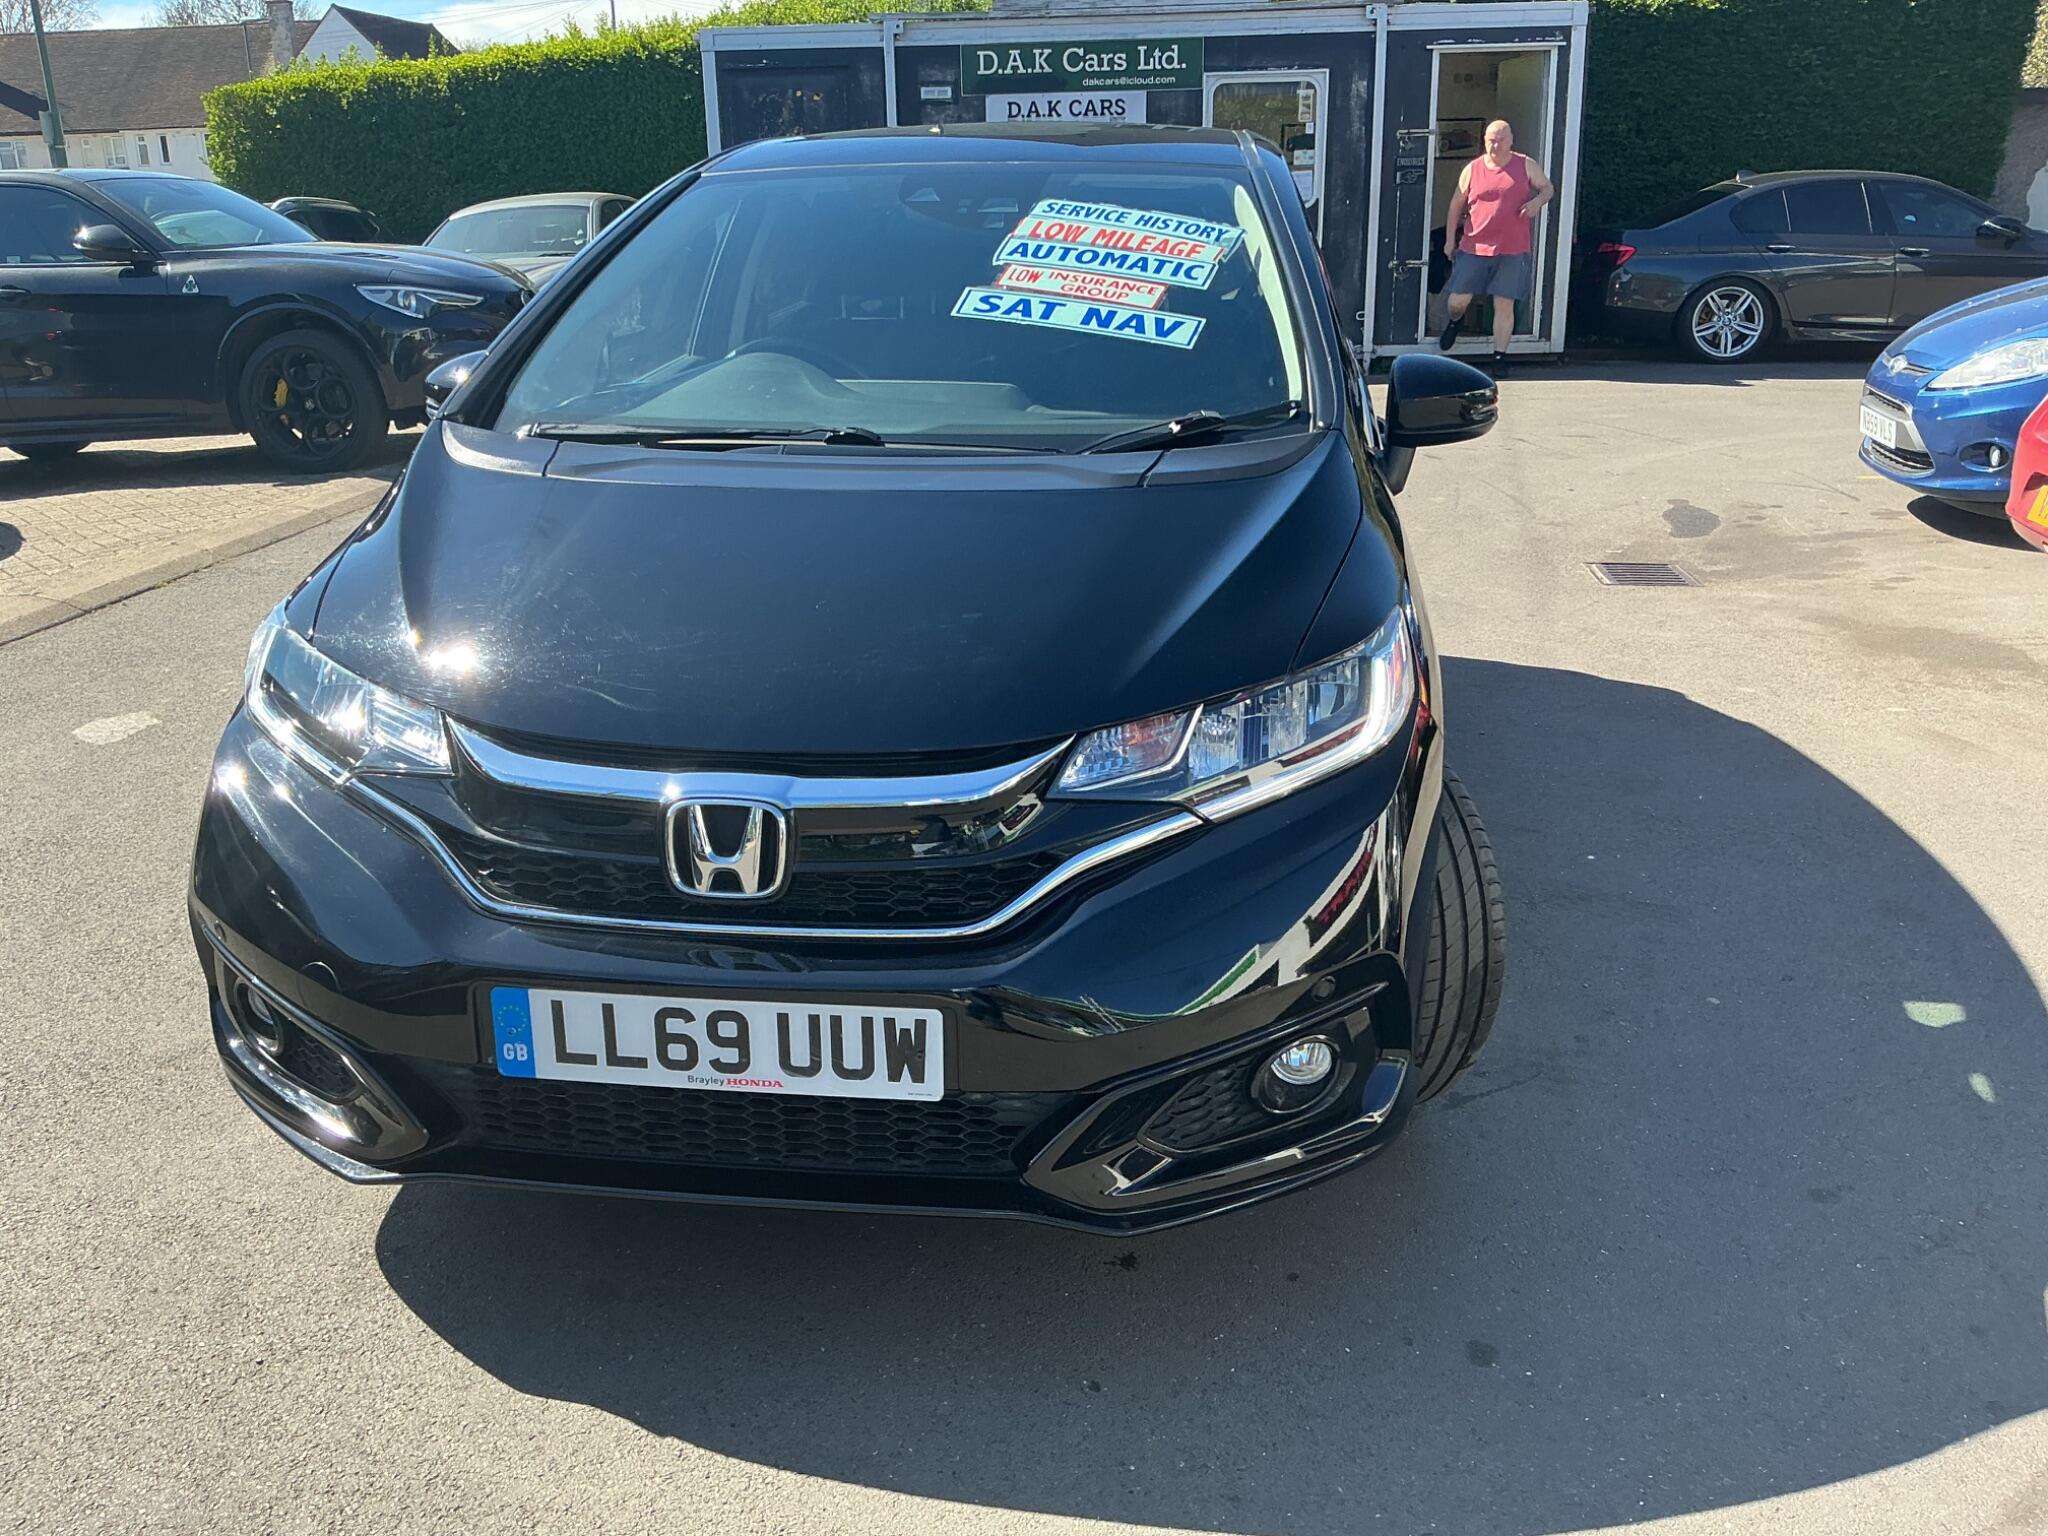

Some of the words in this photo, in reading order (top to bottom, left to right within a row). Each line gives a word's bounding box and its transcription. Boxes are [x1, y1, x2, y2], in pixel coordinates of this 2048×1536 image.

[977, 49, 1053, 75] D.A.K
[1062, 48, 1127, 73] Cars
[1137, 45, 1186, 70] Ltd.
[1082, 75, 1176, 87] dakcars@icloud.com
[1007, 100, 1062, 119] D.A.K
[1069, 99, 1126, 117] CARS
[1042, 201, 1129, 223] SERVICE
[1134, 212, 1231, 243] HISTORY
[1029, 220, 1090, 243] LOW
[1091, 228, 1206, 258] MILEAGE
[1007, 242, 1205, 281] AUTOMATIC
[1008, 267, 1044, 283] LOW
[1048, 271, 1156, 296] INSURANCE
[1060, 283, 1129, 300] GROUP
[972, 294, 1066, 320] SAT
[1079, 307, 1185, 338] NAV
[503, 1042, 528, 1061] GB
[550, 999, 750, 1075] LL69
[776, 1012, 927, 1084] UUW
[688, 1075, 725, 1086] Brayley
[726, 1078, 784, 1088] HONDA
